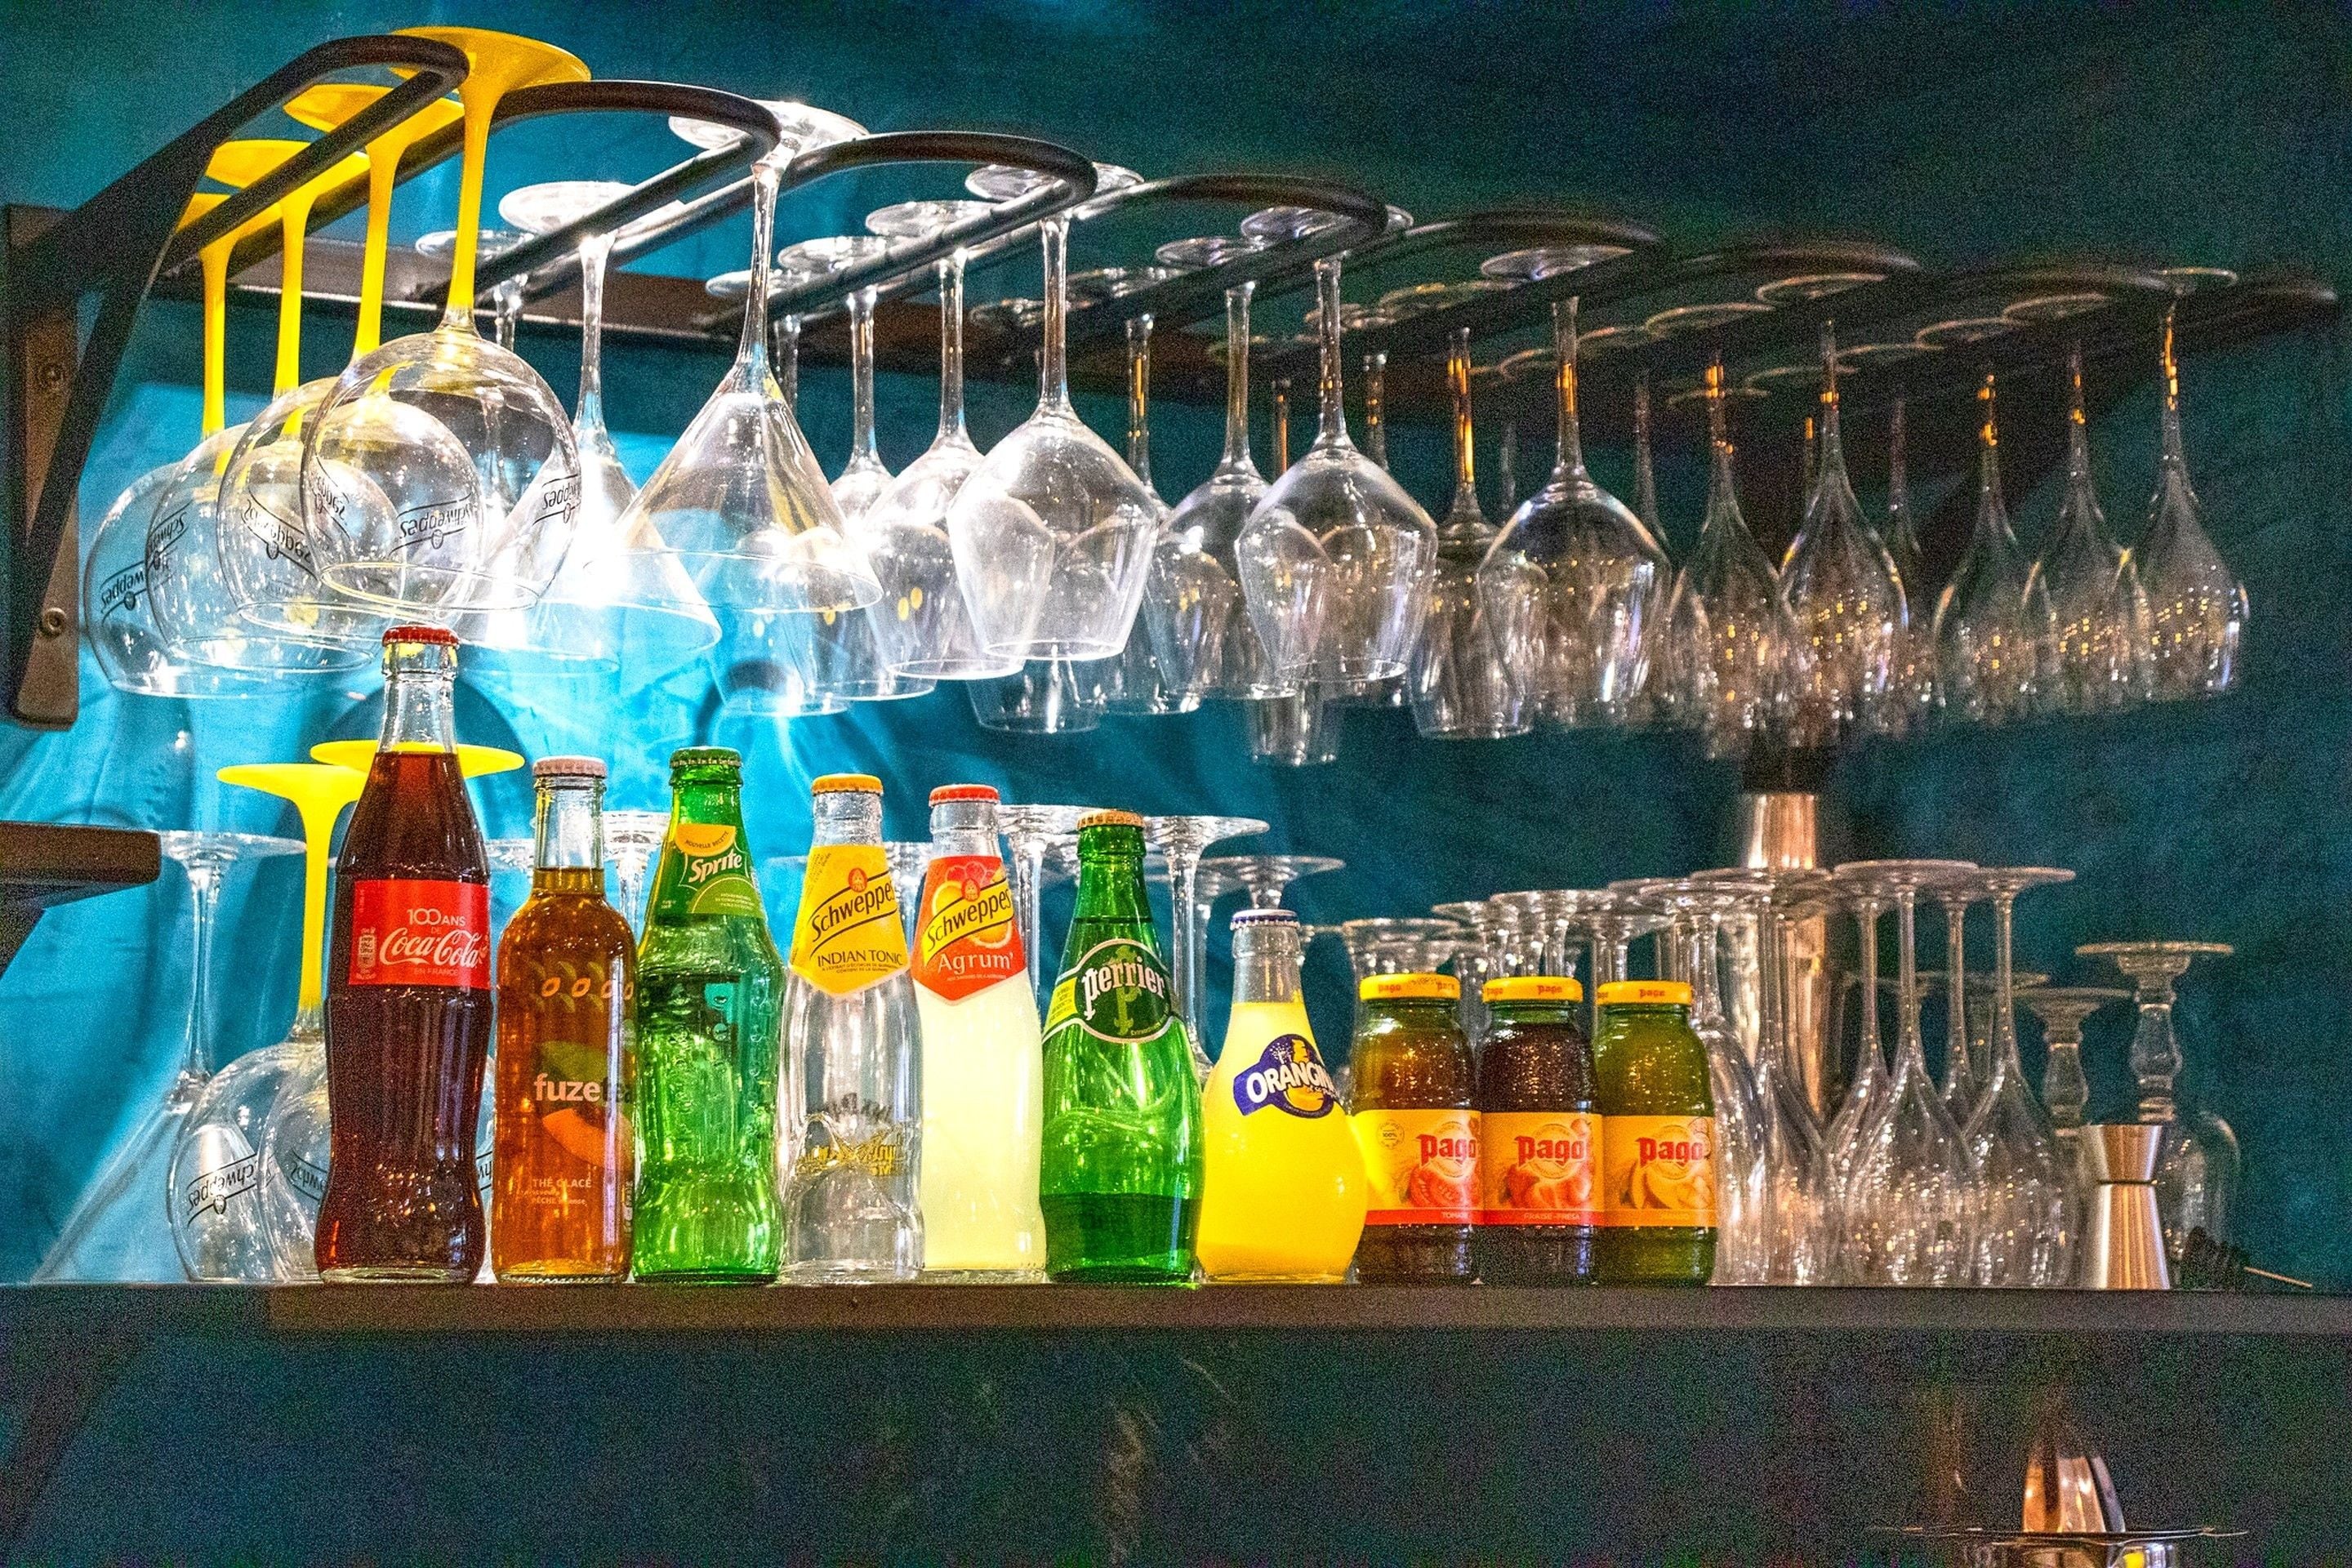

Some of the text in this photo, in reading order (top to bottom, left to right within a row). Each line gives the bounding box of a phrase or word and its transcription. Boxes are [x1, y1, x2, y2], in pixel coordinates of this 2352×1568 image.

[688, 849, 743, 883] Sprite
[380, 927, 482, 969] Coca-Cola
[817, 950, 866, 967] INDIAN
[868, 949, 903, 966] TONIC
[428, 968, 459, 977] FRANCE
[1247, 1062, 1336, 1103] ORANGIN
[1415, 1134, 1477, 1166] pago
[1513, 1134, 1584, 1167] pago
[1635, 1136, 1703, 1168] pago
